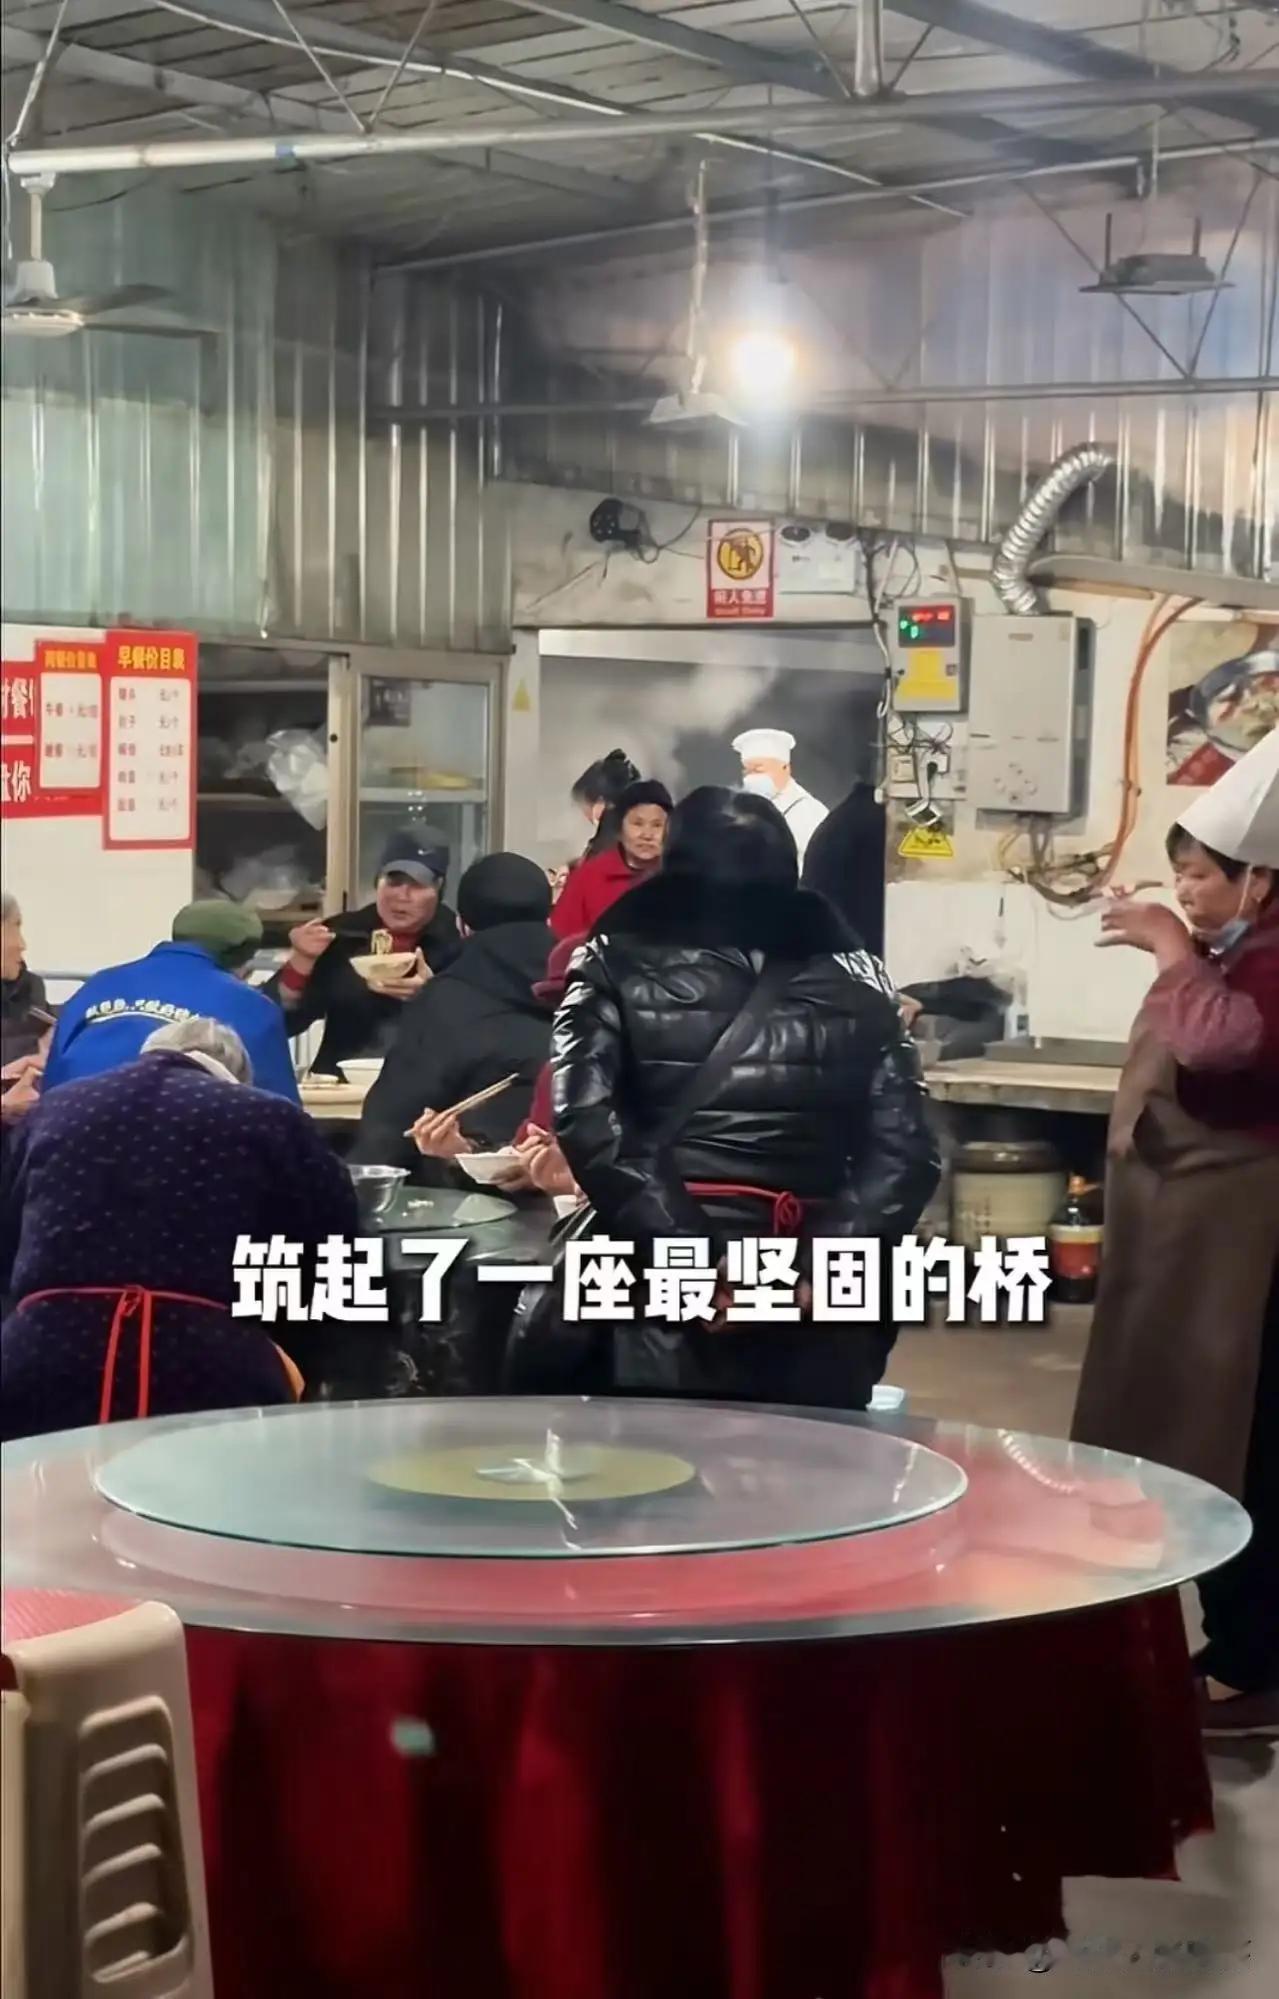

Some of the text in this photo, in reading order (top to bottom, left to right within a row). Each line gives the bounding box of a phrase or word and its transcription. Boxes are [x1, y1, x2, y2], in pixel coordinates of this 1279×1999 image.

[118, 645, 185, 671] 早餐价目表
